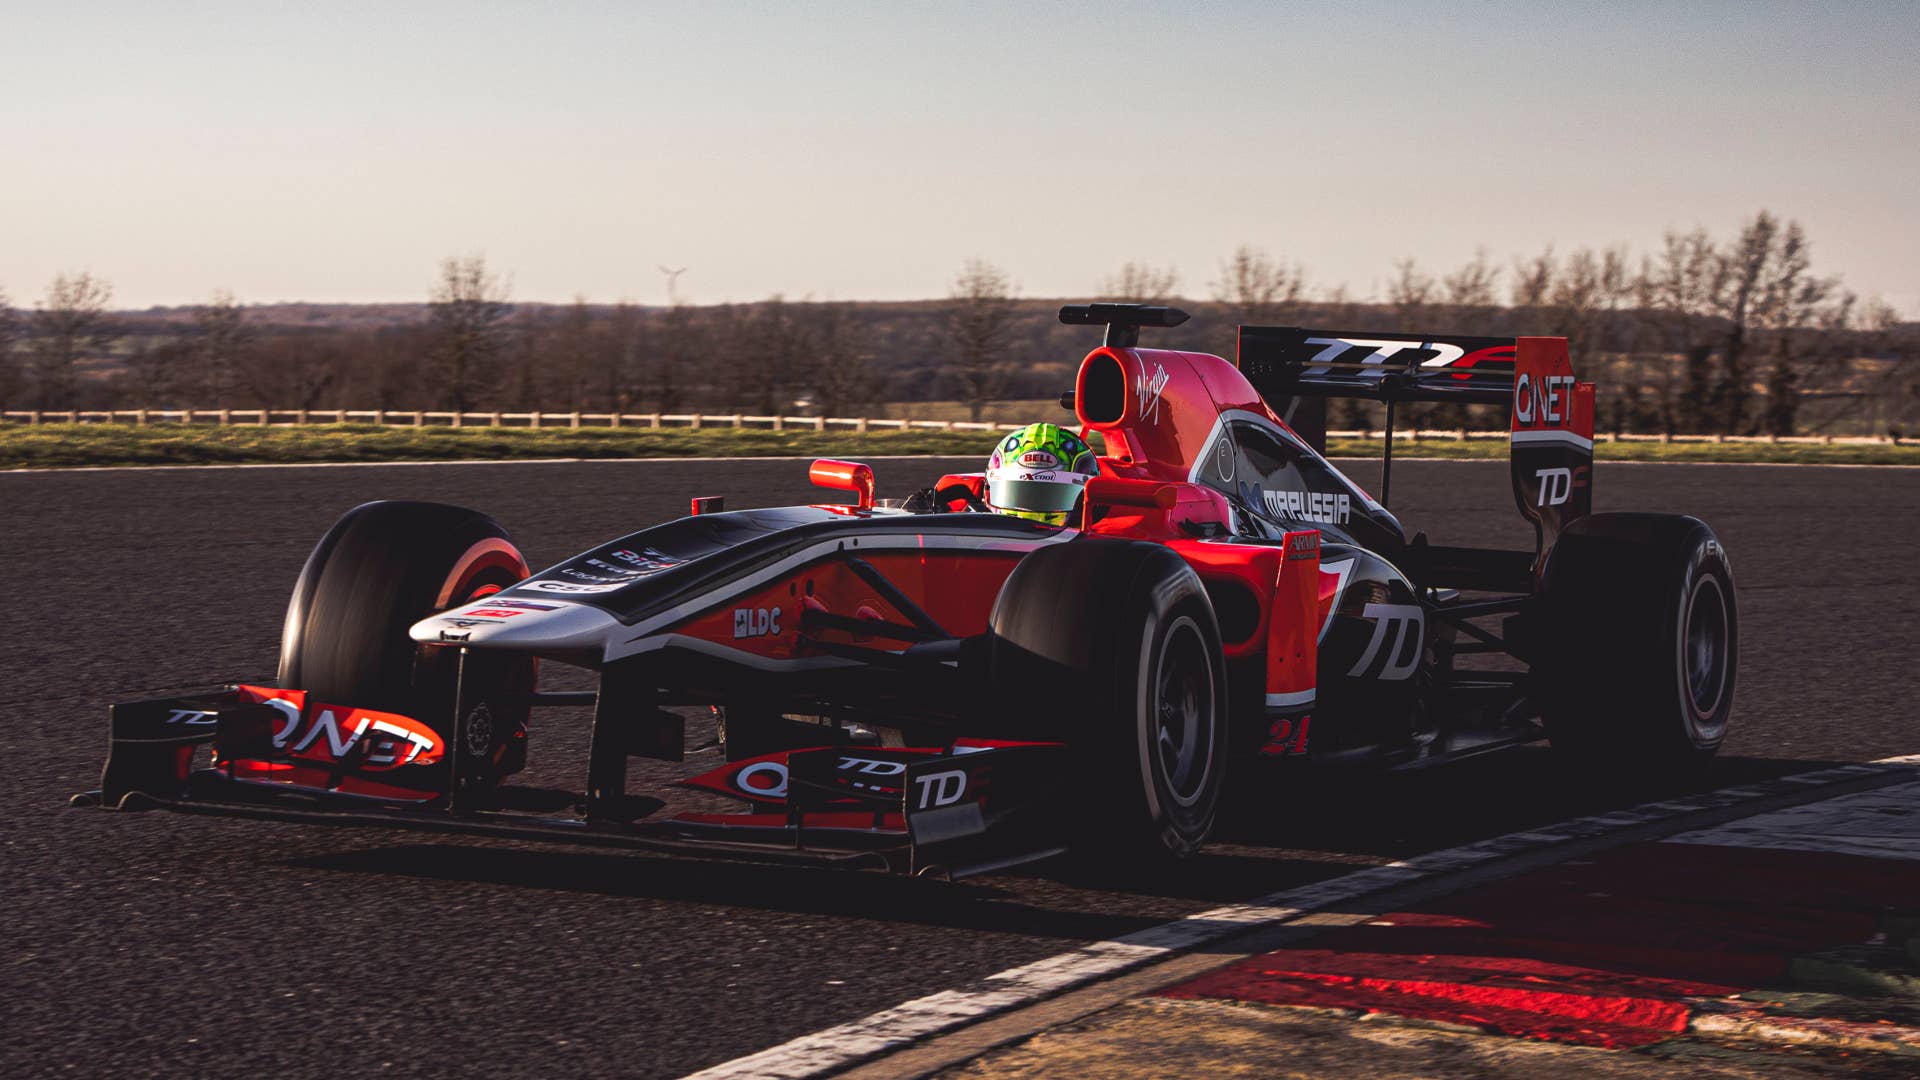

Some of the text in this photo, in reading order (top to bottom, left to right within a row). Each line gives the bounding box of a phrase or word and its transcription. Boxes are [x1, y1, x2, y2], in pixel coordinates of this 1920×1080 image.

[1136, 352, 1169, 426] Virgin
[1516, 374, 1575, 423] QNET
[1023, 454, 1053, 464] BELL
[1263, 490, 1350, 525] MARUSSIA
[748, 607, 781, 636] LDC
[1260, 715, 1310, 755] 24
